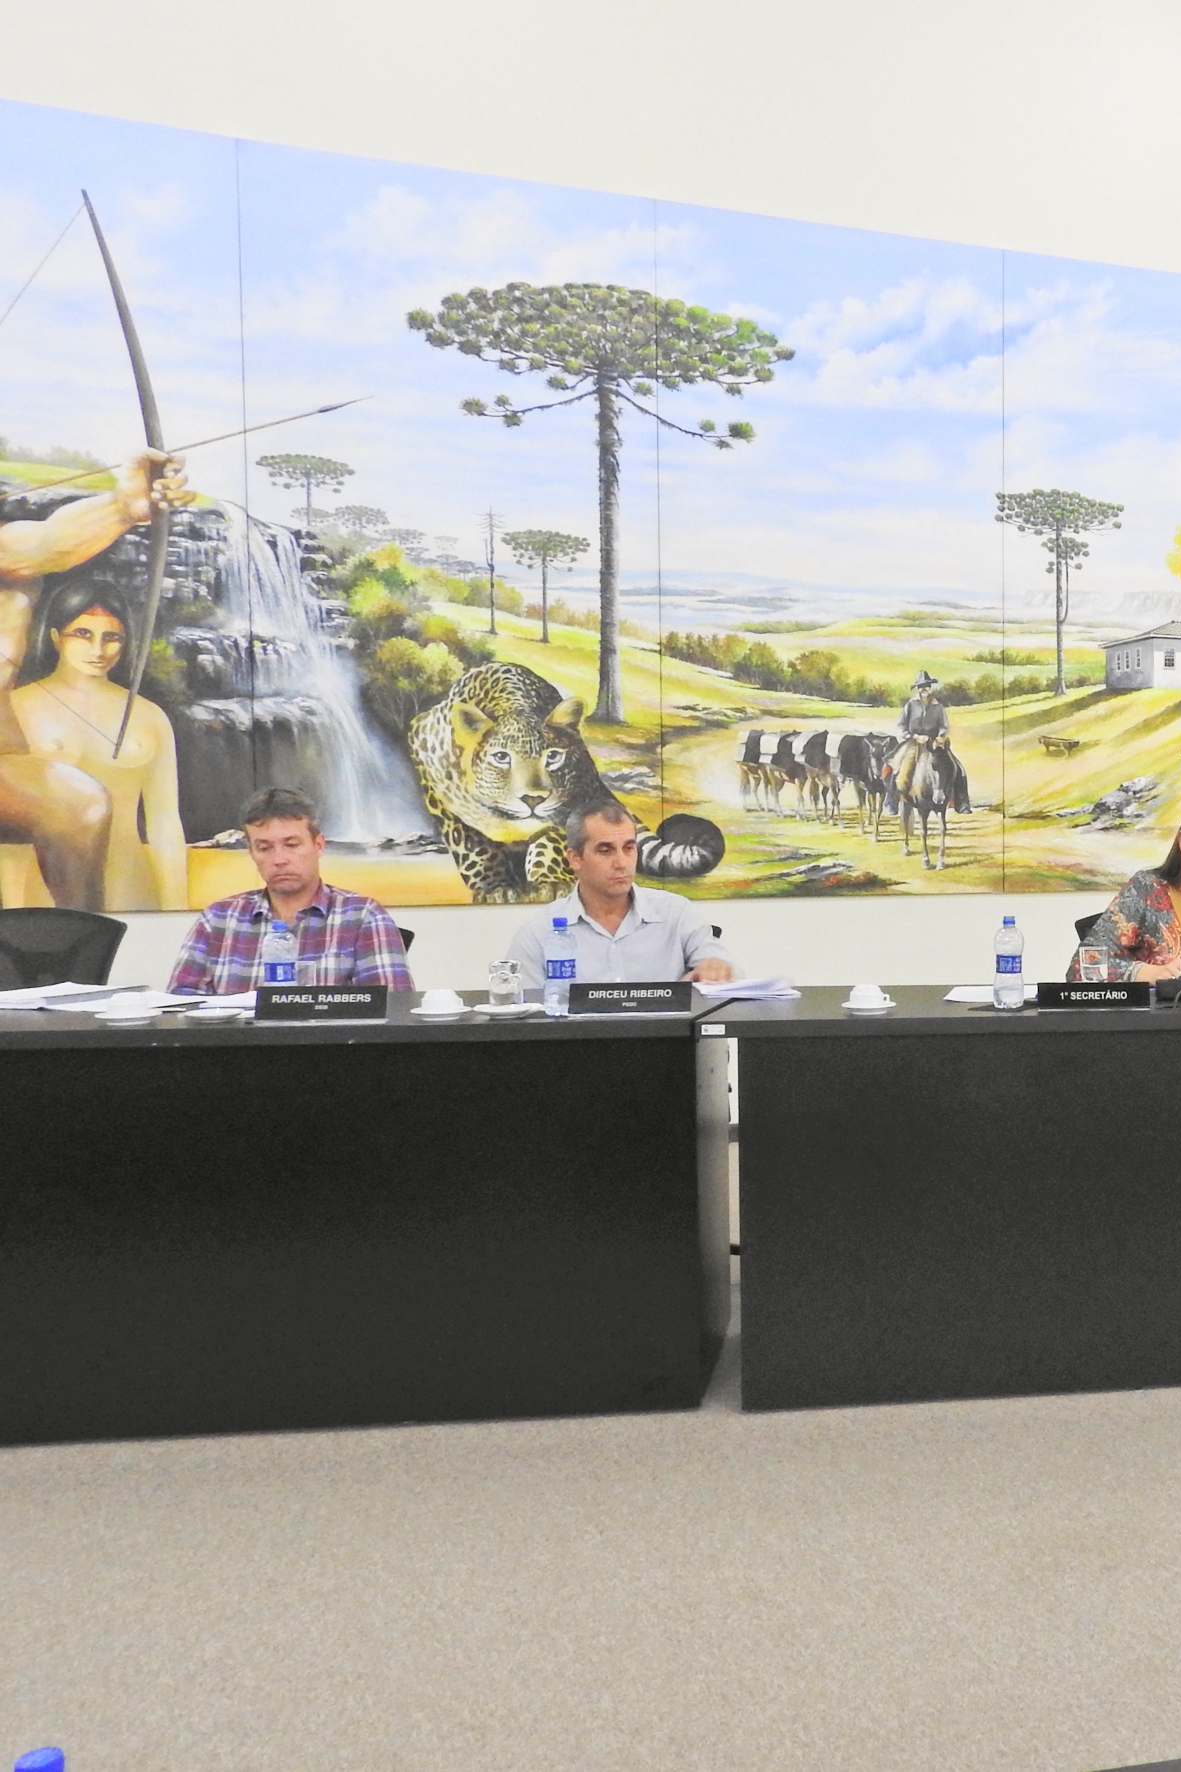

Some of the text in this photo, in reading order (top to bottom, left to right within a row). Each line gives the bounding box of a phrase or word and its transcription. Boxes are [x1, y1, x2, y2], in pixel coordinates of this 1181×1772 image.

[271, 994, 372, 1003] RAFAEL RABBERS
[588, 989, 672, 999] DIRCEU RIBEIRO
[1071, 989, 1128, 1000] SECRETÁRIO
